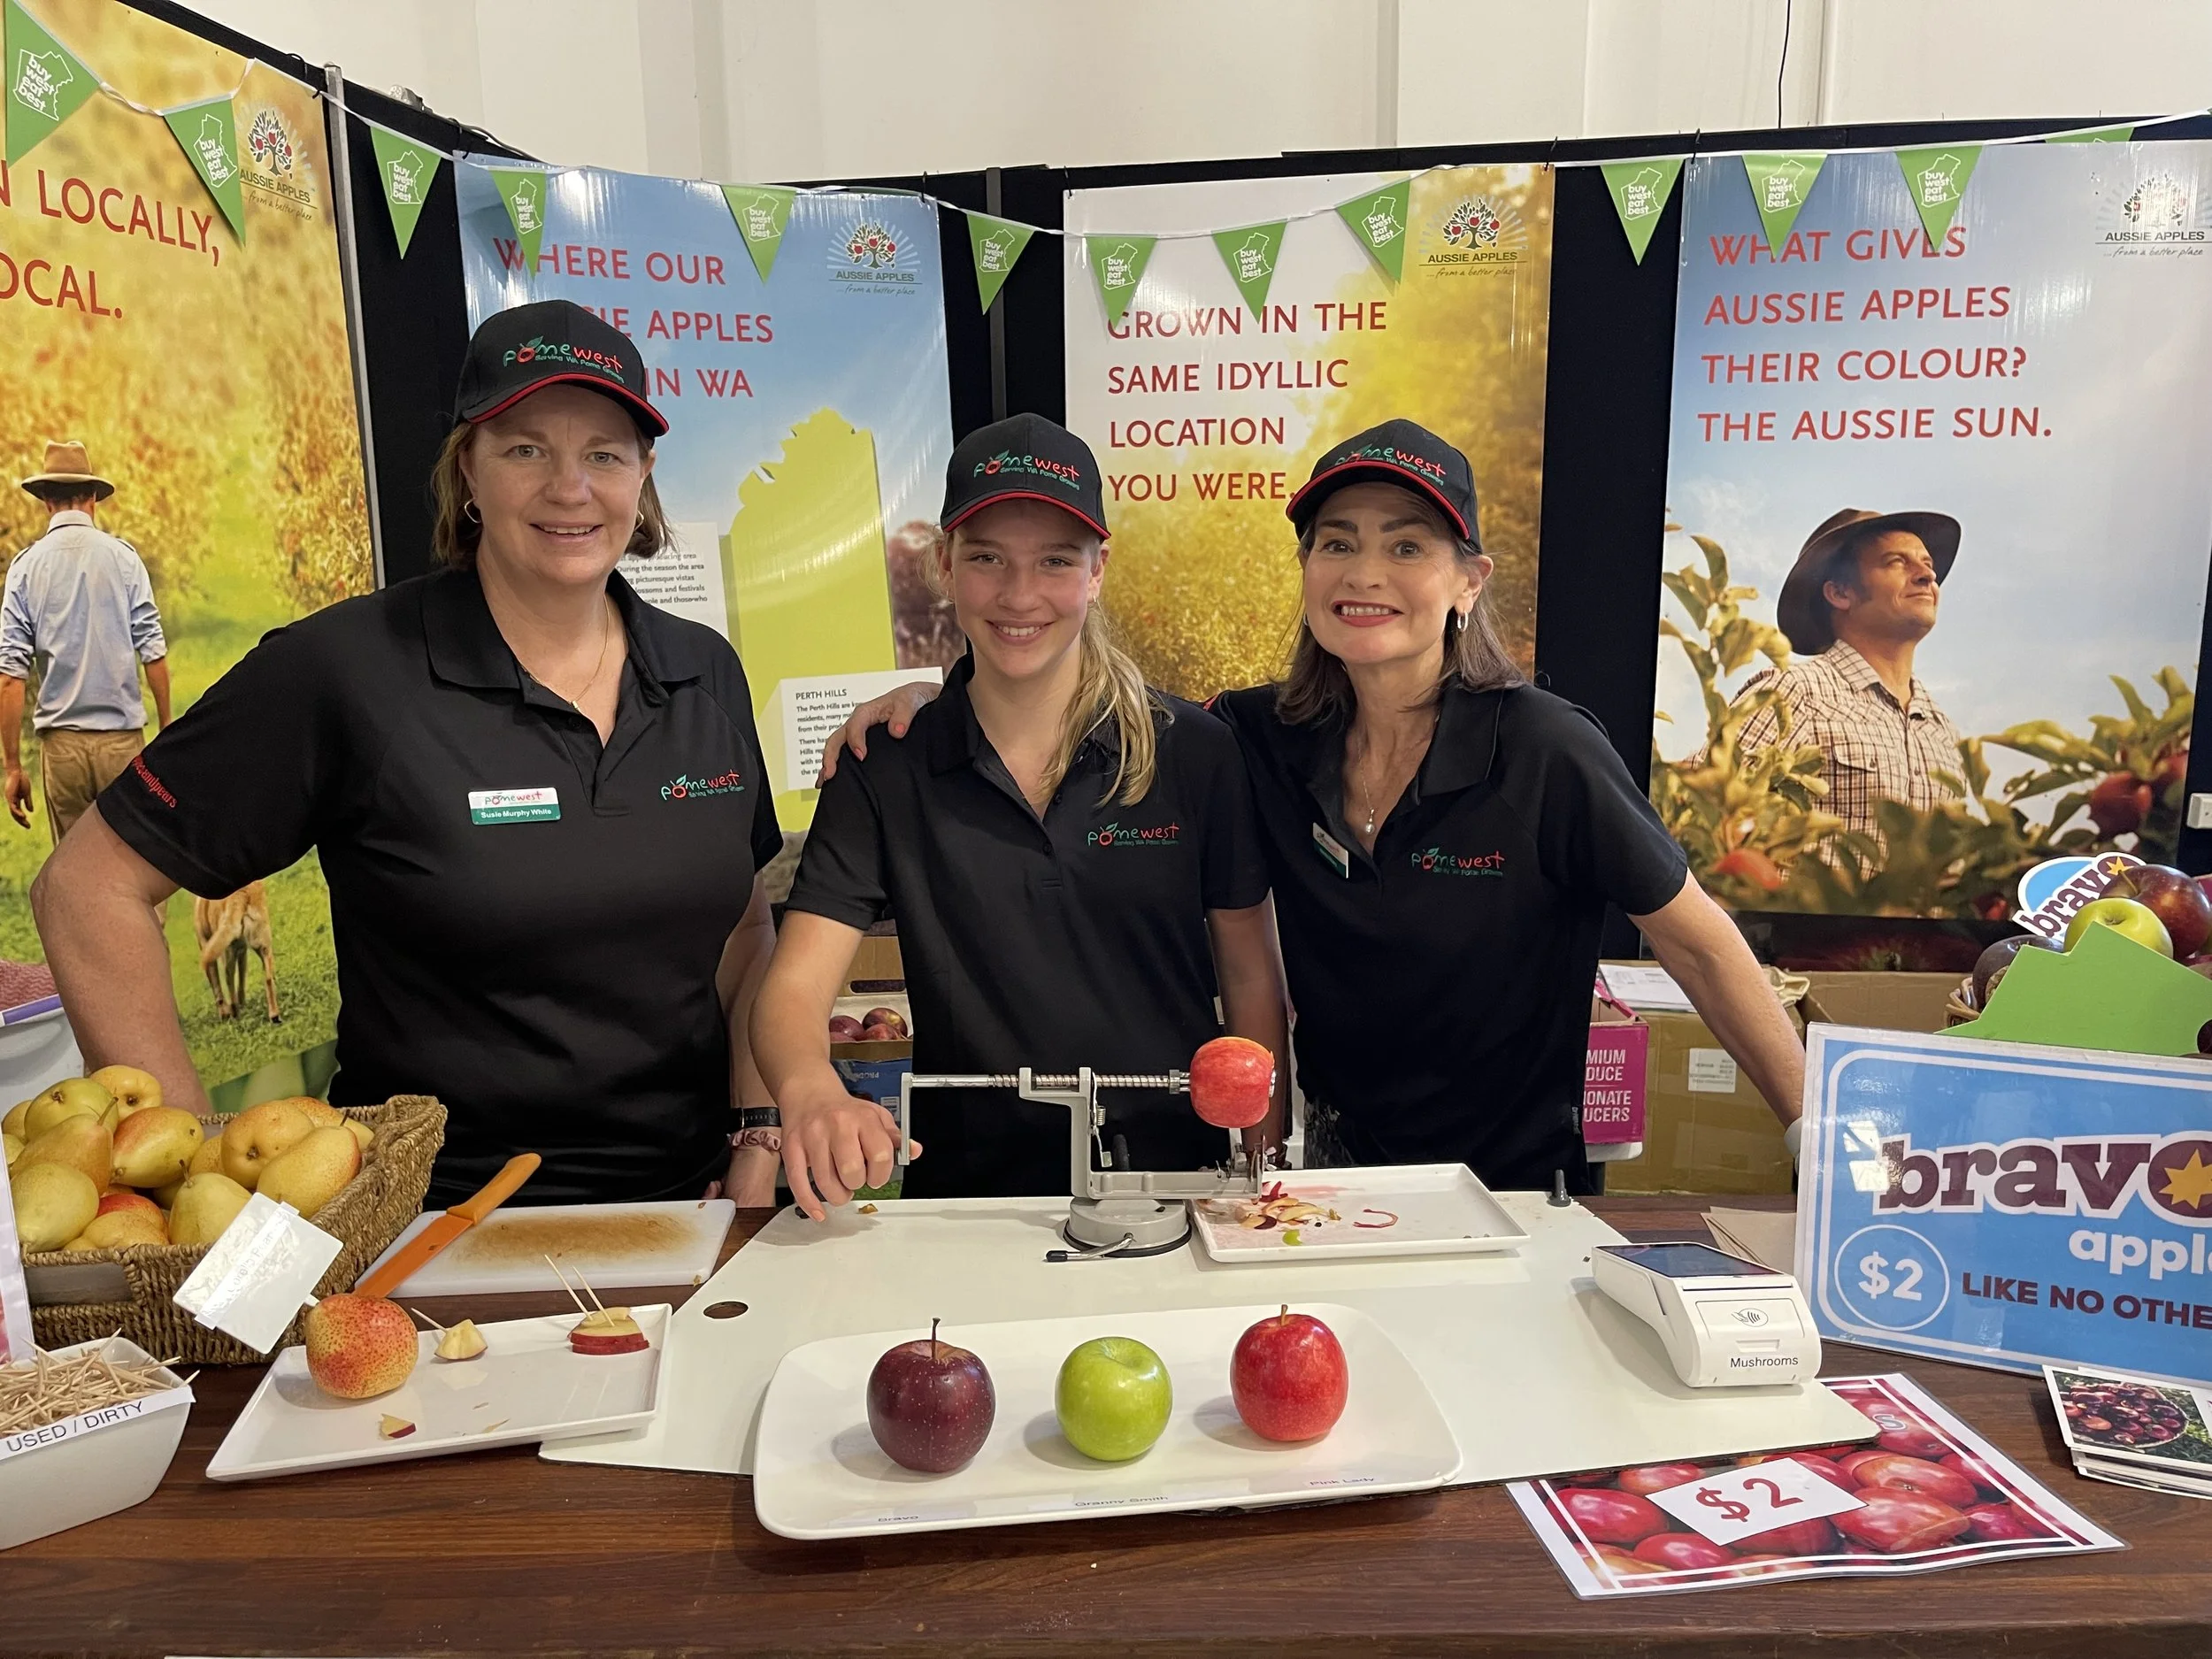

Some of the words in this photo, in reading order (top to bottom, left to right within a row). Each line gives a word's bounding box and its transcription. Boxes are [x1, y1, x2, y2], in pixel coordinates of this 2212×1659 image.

[28, 55, 52, 81] buy
[22, 76, 43, 97] eat
[27, 65, 55, 95] west
[18, 86, 46, 111] best
[199, 139, 216, 150] buy
[204, 146, 223, 160] west
[207, 157, 221, 170] eat
[393, 163, 410, 176] buy
[209, 166, 228, 180] best
[394, 173, 413, 187] west
[1925, 171, 1945, 180] buy
[241, 170, 274, 189] AUSSIE
[276, 182, 310, 203] APPLES
[393, 182, 408, 193] eat
[1770, 177, 1788, 186] buy
[1925, 177, 1950, 187] west
[1628, 184, 1647, 194] buy
[1628, 191, 1652, 200] west
[1925, 186, 1943, 195] eat
[393, 191, 411, 203] best
[515, 196, 529, 206] buy
[1768, 198, 1789, 207] best
[1924, 193, 1947, 202] best
[517, 204, 534, 213] west
[1628, 205, 1649, 214] best
[38, 169, 219, 267] LOCALLY,
[519, 219, 534, 228] best
[1368, 212, 1386, 224] buy
[1370, 216, 1392, 231] west
[1372, 227, 1387, 236] eat
[1374, 230, 1394, 244] best
[2105, 232, 2151, 241] AUSSIE
[2154, 230, 2205, 241] APPLES
[986, 239, 1002, 250] buy
[1709, 230, 1831, 265] WHAT
[985, 248, 1003, 257] west
[1240, 249, 1256, 257] buy
[1240, 255, 1262, 264] west
[1428, 253, 1469, 264] AUSSIE
[1472, 251, 1518, 262] APPLES
[493, 238, 630, 280] WHERE
[646, 253, 726, 285] OUR
[836, 271, 872, 280] AUSSIE
[876, 273, 915, 281] APPLES
[1242, 269, 1262, 278] best
[1704, 291, 1844, 326] AUSSIE
[1861, 287, 2010, 319] APPLES
[647, 310, 773, 343] APPLES
[1108, 306, 1240, 340] GROWN
[1262, 304, 1297, 333] IN
[1314, 301, 1387, 331] THE
[503, 339, 623, 373] pomewest
[1701, 353, 1819, 383] THEIR
[1837, 347, 2026, 381] COLOUR?
[696, 370, 754, 397] WA
[1108, 364, 1200, 394] SAME
[1217, 359, 1348, 391] IDYLLIC
[1698, 412, 1777, 442] THE
[1793, 409, 1934, 442] AUSSIE
[1952, 407, 2053, 438] SUN.
[1110, 417, 1285, 448] LOCATION
[973, 451, 1079, 481] pomewest
[1108, 474, 1177, 501] YOU
[1193, 472, 1296, 500] WERE.
[796, 691, 821, 700] PERTH
[661, 769, 740, 800] pomewest
[485, 791, 542, 805] pomewest
[1088, 821, 1179, 846] pomewest
[1411, 848, 1504, 870] pomewest
[1586, 1049, 1626, 1064] MIUM
[1586, 1067, 1624, 1081] DUCE
[1584, 1108, 1630, 1122] UCERS
[2069, 1230, 2212, 1279] appl
[1858, 1251, 1924, 1302] $2
[1962, 1272, 2038, 1304] LIKE
[2049, 1286, 2104, 1313] NO
[1731, 1356, 1798, 1368] Mushrooms
[7, 1425, 67, 1452] USED
[85, 1402, 143, 1429] DIRTY
[1696, 1478, 1803, 1522] $2
